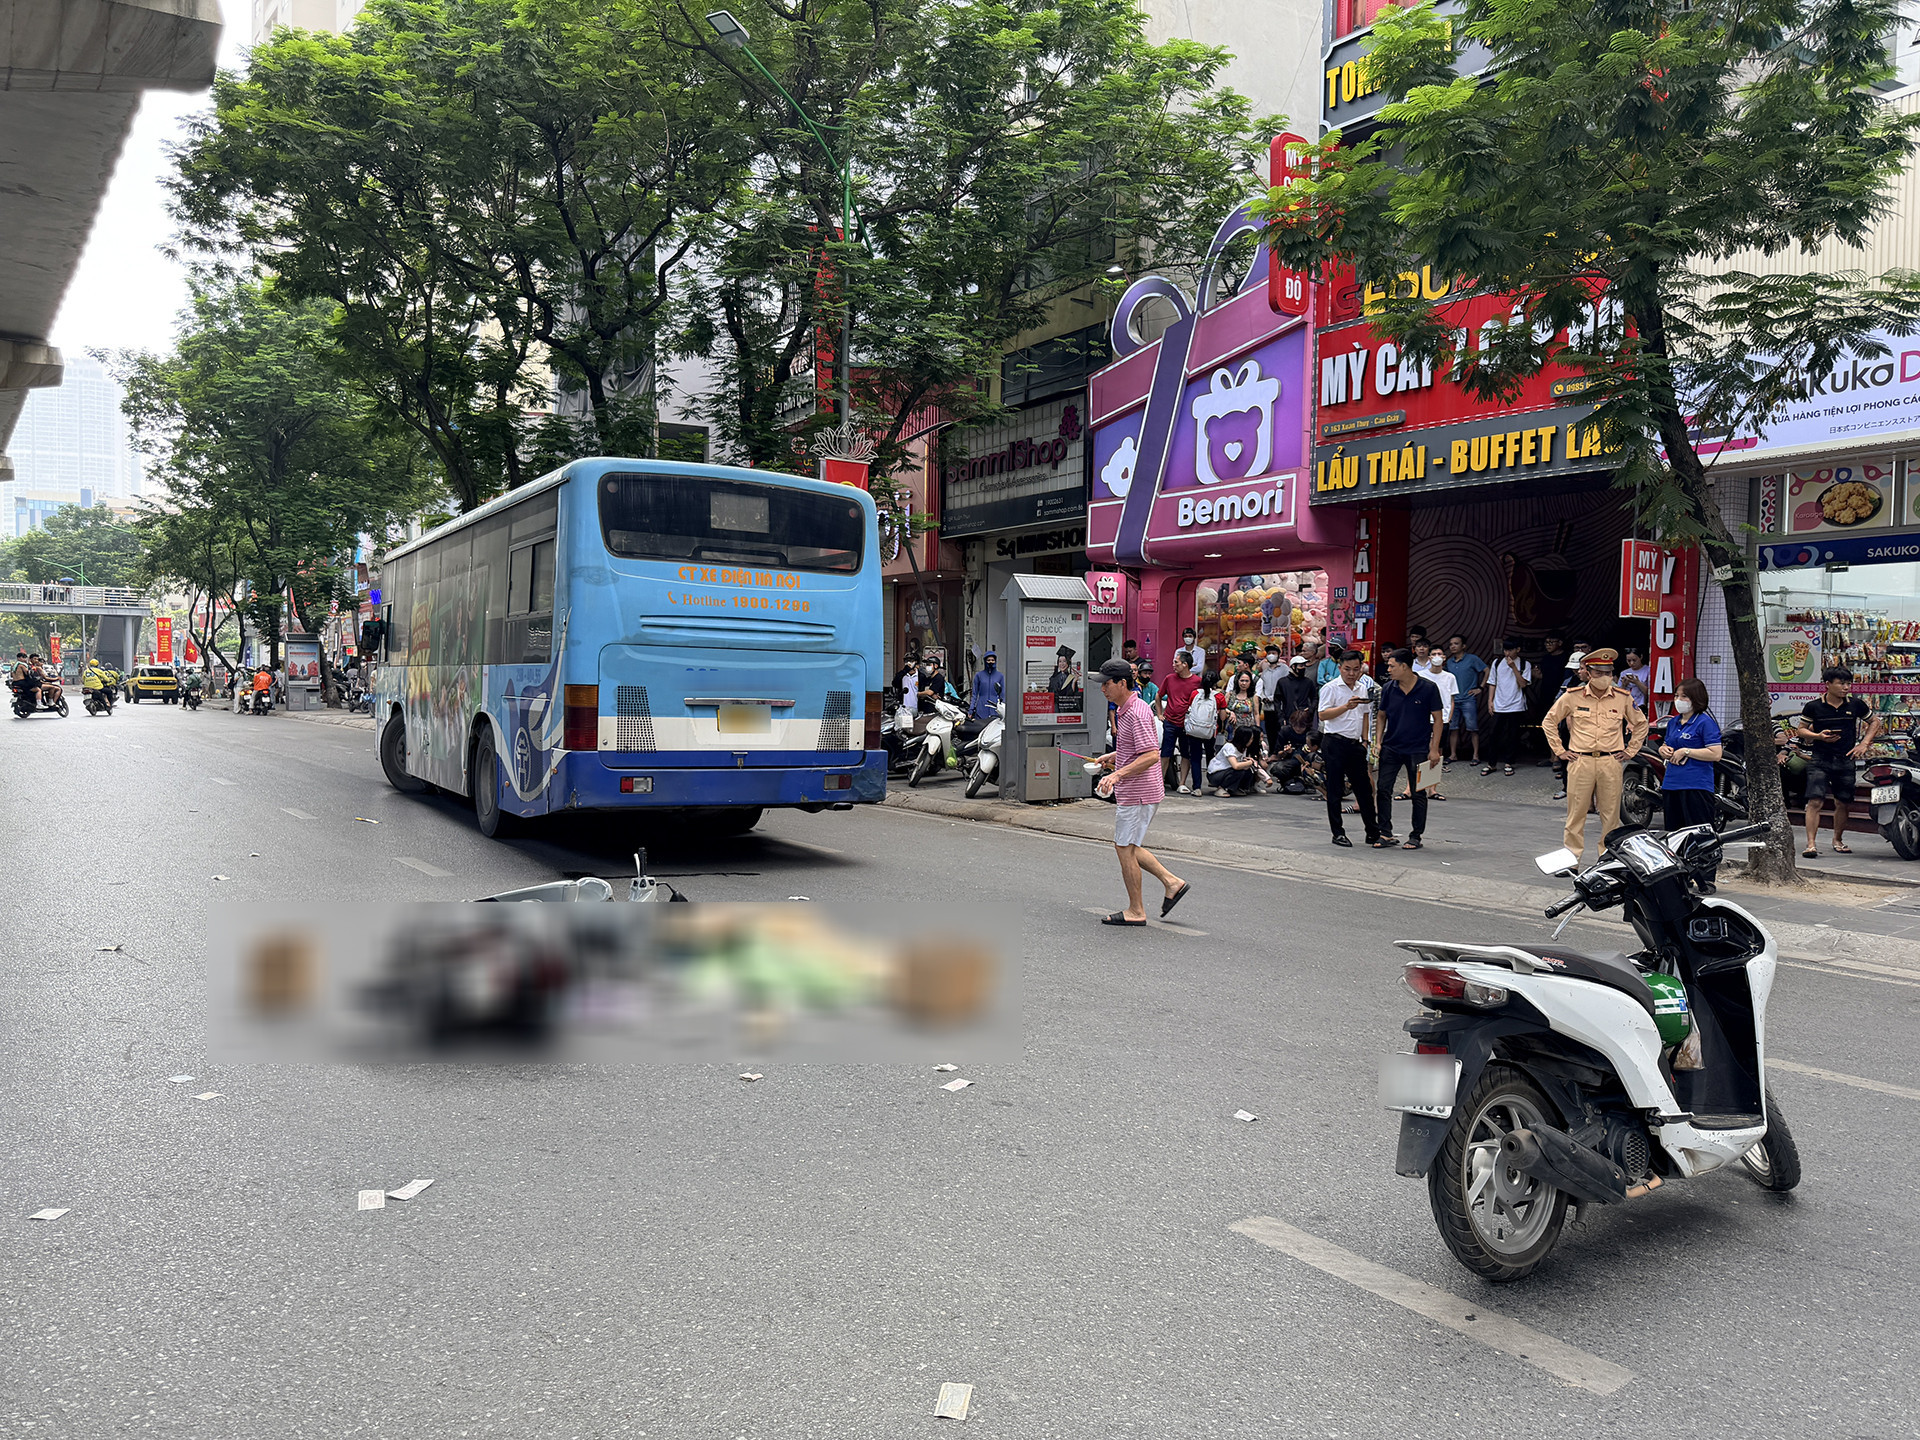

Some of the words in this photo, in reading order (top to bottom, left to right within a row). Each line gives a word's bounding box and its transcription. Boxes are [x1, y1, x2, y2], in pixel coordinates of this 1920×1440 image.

[1286, 275, 1302, 305] ĐỘ
[1321, 342, 1368, 407] MỲ
[1793, 409, 1821, 421] HÀNG
[1824, 405, 1844, 419] TIỆN
[1846, 403, 1862, 415] LỢI
[1863, 398, 1901, 412] PHONG
[1317, 445, 1359, 492] LẨU
[1366, 440, 1426, 485] THÁI
[1433, 457, 1444, 465] -
[1450, 425, 1557, 474] BUFFET
[1178, 480, 1285, 527] Bemori
[1639, 548, 1659, 570] MỲ
[1867, 545, 1920, 558] SAKUKO
[678, 566, 698, 581] CT
[700, 567, 717, 583] XE
[1636, 572, 1659, 592] CAY
[682, 594, 727, 607] Hotline
[1335, 587, 1347, 598] 161
[1091, 604, 1123, 615] Bemori
[1026, 615, 1040, 624] TIẾP
[1026, 624, 1040, 633] GIÁO
